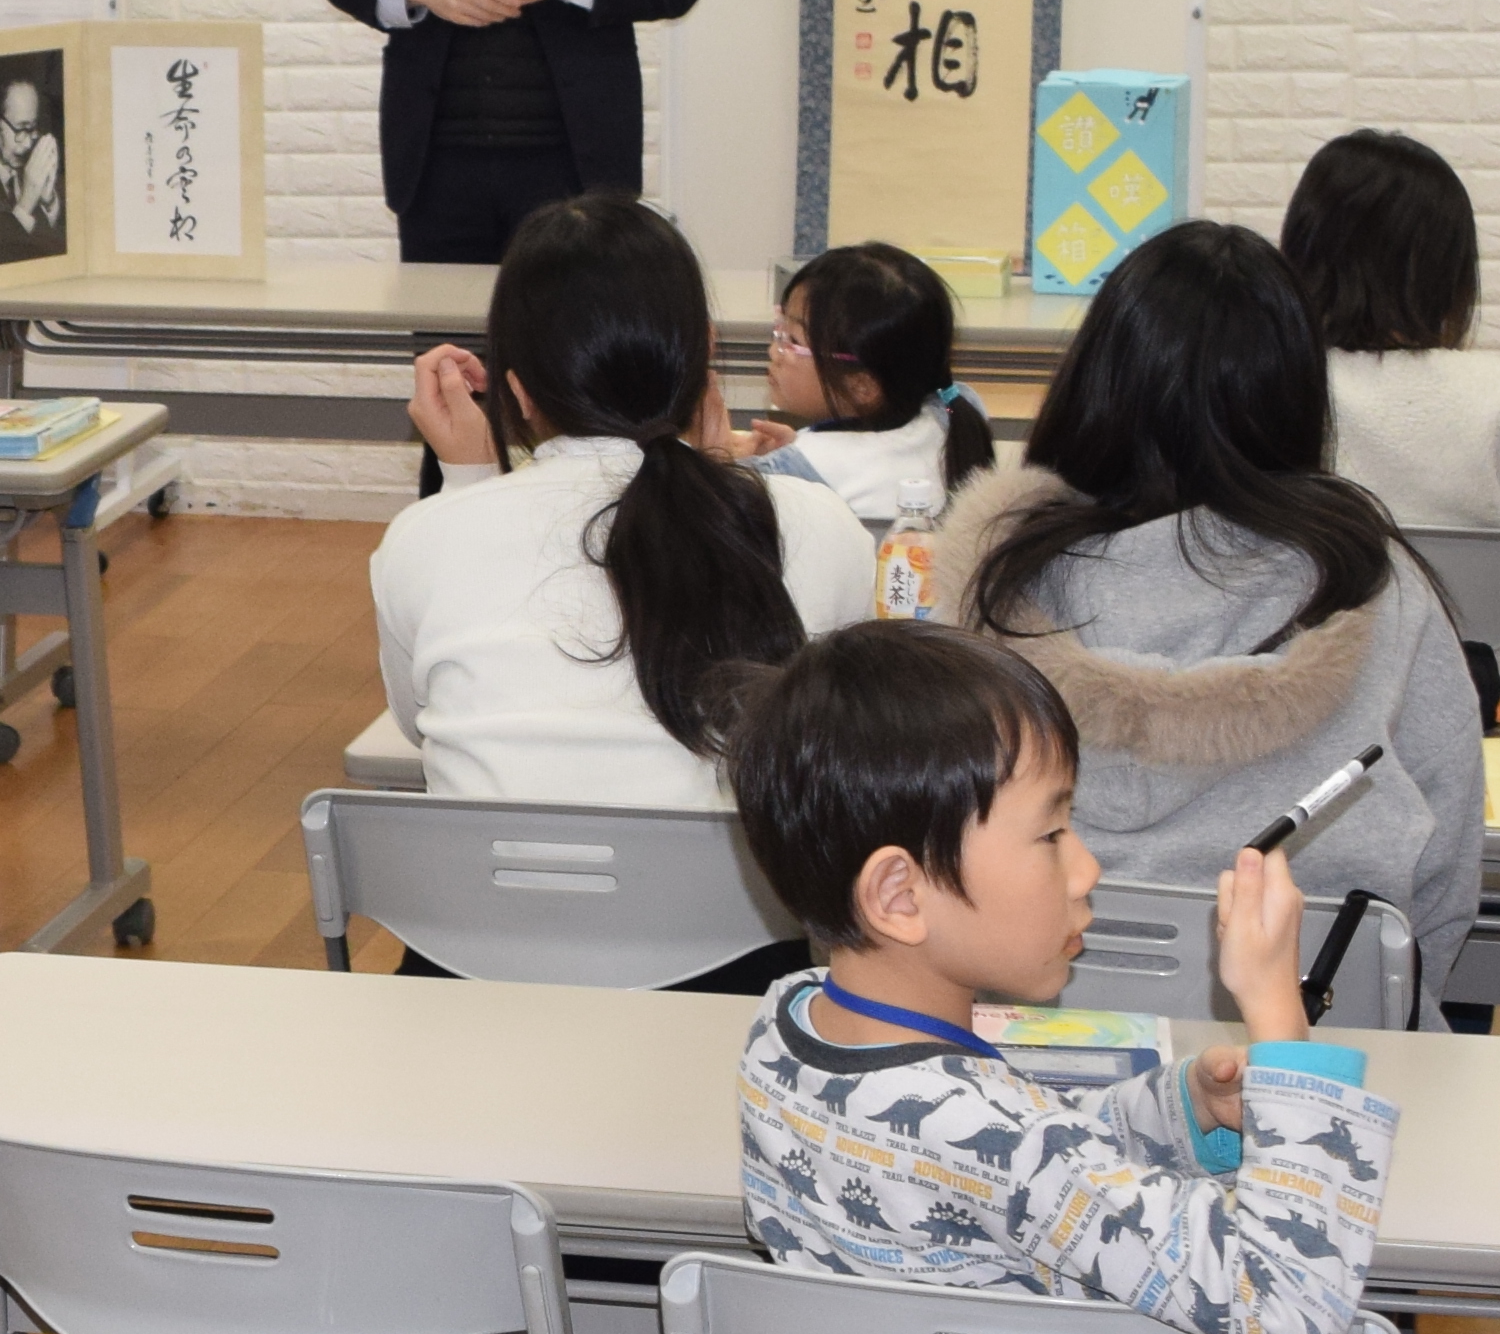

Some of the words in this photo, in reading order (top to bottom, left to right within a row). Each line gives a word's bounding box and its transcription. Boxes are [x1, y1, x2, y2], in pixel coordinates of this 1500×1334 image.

[889, 565, 906, 606] 麦茶
[1251, 1069, 1344, 1101] ADVENTURES
[886, 1138, 908, 1152] TRAIL
[911, 1145, 941, 1162] BLAZER
[882, 1170, 905, 1183] TRAIL
[908, 1175, 940, 1192] BLAZER
[914, 1159, 993, 1200] ADVENTURES
[953, 1161, 979, 1176] TRAIL
[982, 1170, 1009, 1187] BLAZ
[952, 1191, 978, 1206] TRAIL
